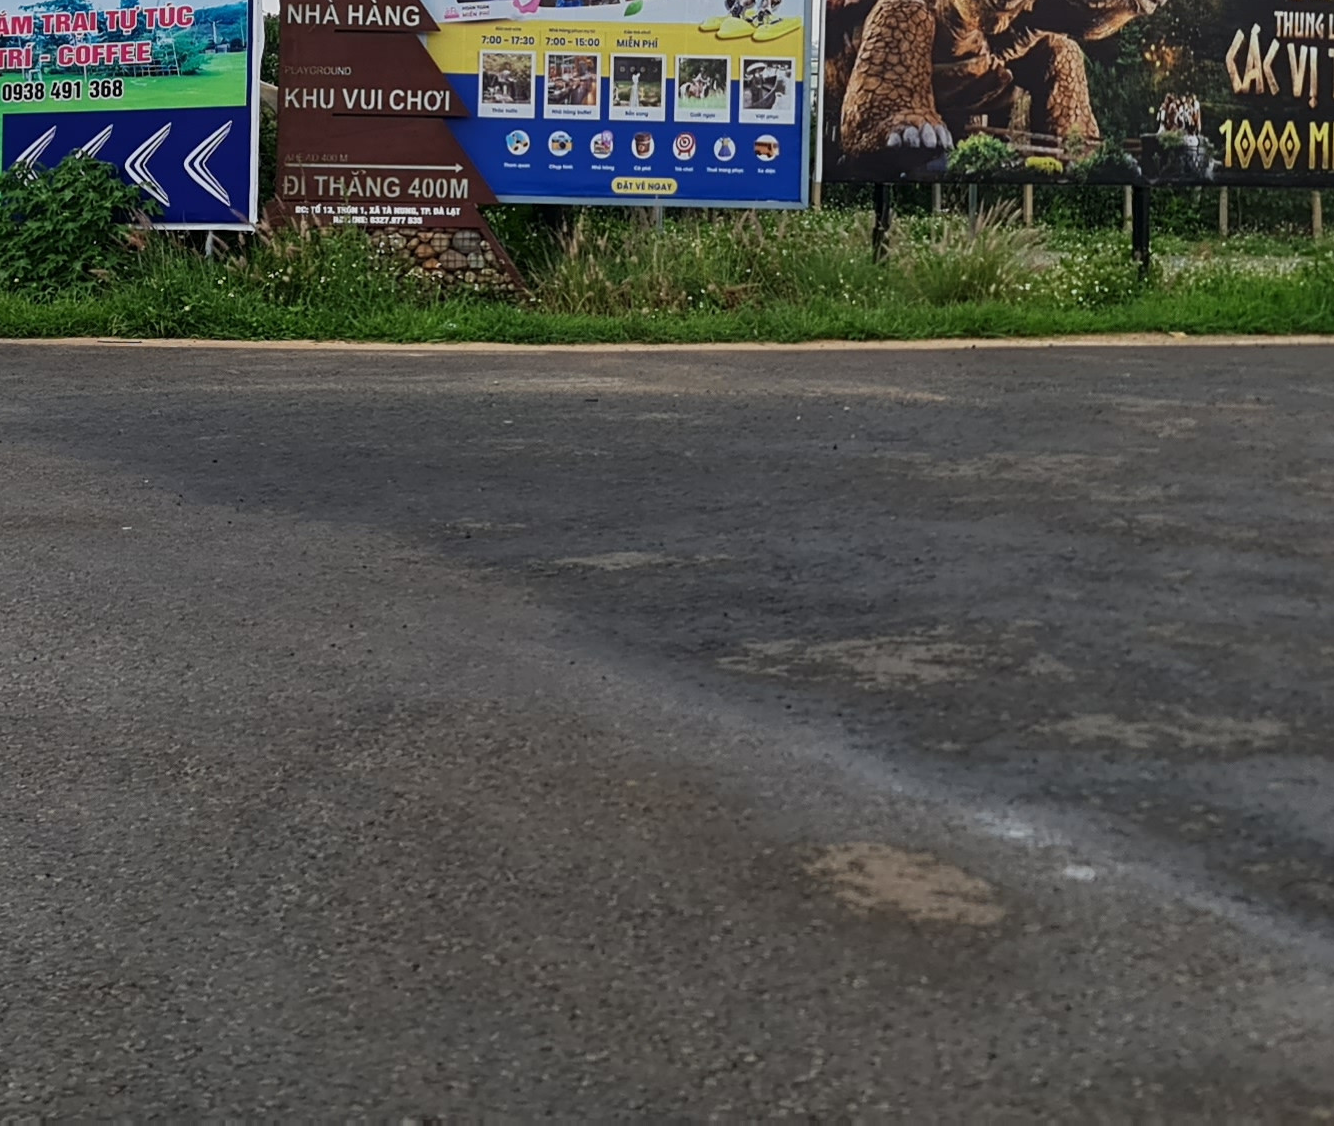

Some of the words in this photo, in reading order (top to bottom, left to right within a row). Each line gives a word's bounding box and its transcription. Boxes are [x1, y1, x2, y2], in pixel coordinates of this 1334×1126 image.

[41, 10, 98, 37] TRẠI
[106, 6, 140, 34] TỰ
[143, 2, 195, 28] TÚC
[347, 0, 420, 27] HÀNG
[1274, 10, 1324, 38] THUNG
[481, 35, 502, 45] 7:00
[545, 36, 566, 46] 7:00
[575, 37, 600, 47] 15:00
[57, 41, 152, 66] COFFEE
[1225, 23, 1280, 96] CÁC
[1286, 42, 1318, 109] VỊ
[284, 65, 352, 76] PLAYGROUND
[1, 82, 45, 102] 0938
[50, 81, 82, 99] 491
[88, 79, 123, 98] 368
[284, 87, 335, 109] KHU
[342, 88, 383, 111] VUI
[389, 89, 450, 112] CHƠI
[1218, 118, 1302, 170] 1000
[1308, 121, 1330, 170] M
[281, 174, 306, 196] ĐI
[313, 169, 401, 198] THẲNG
[407, 177, 469, 199] 400M
